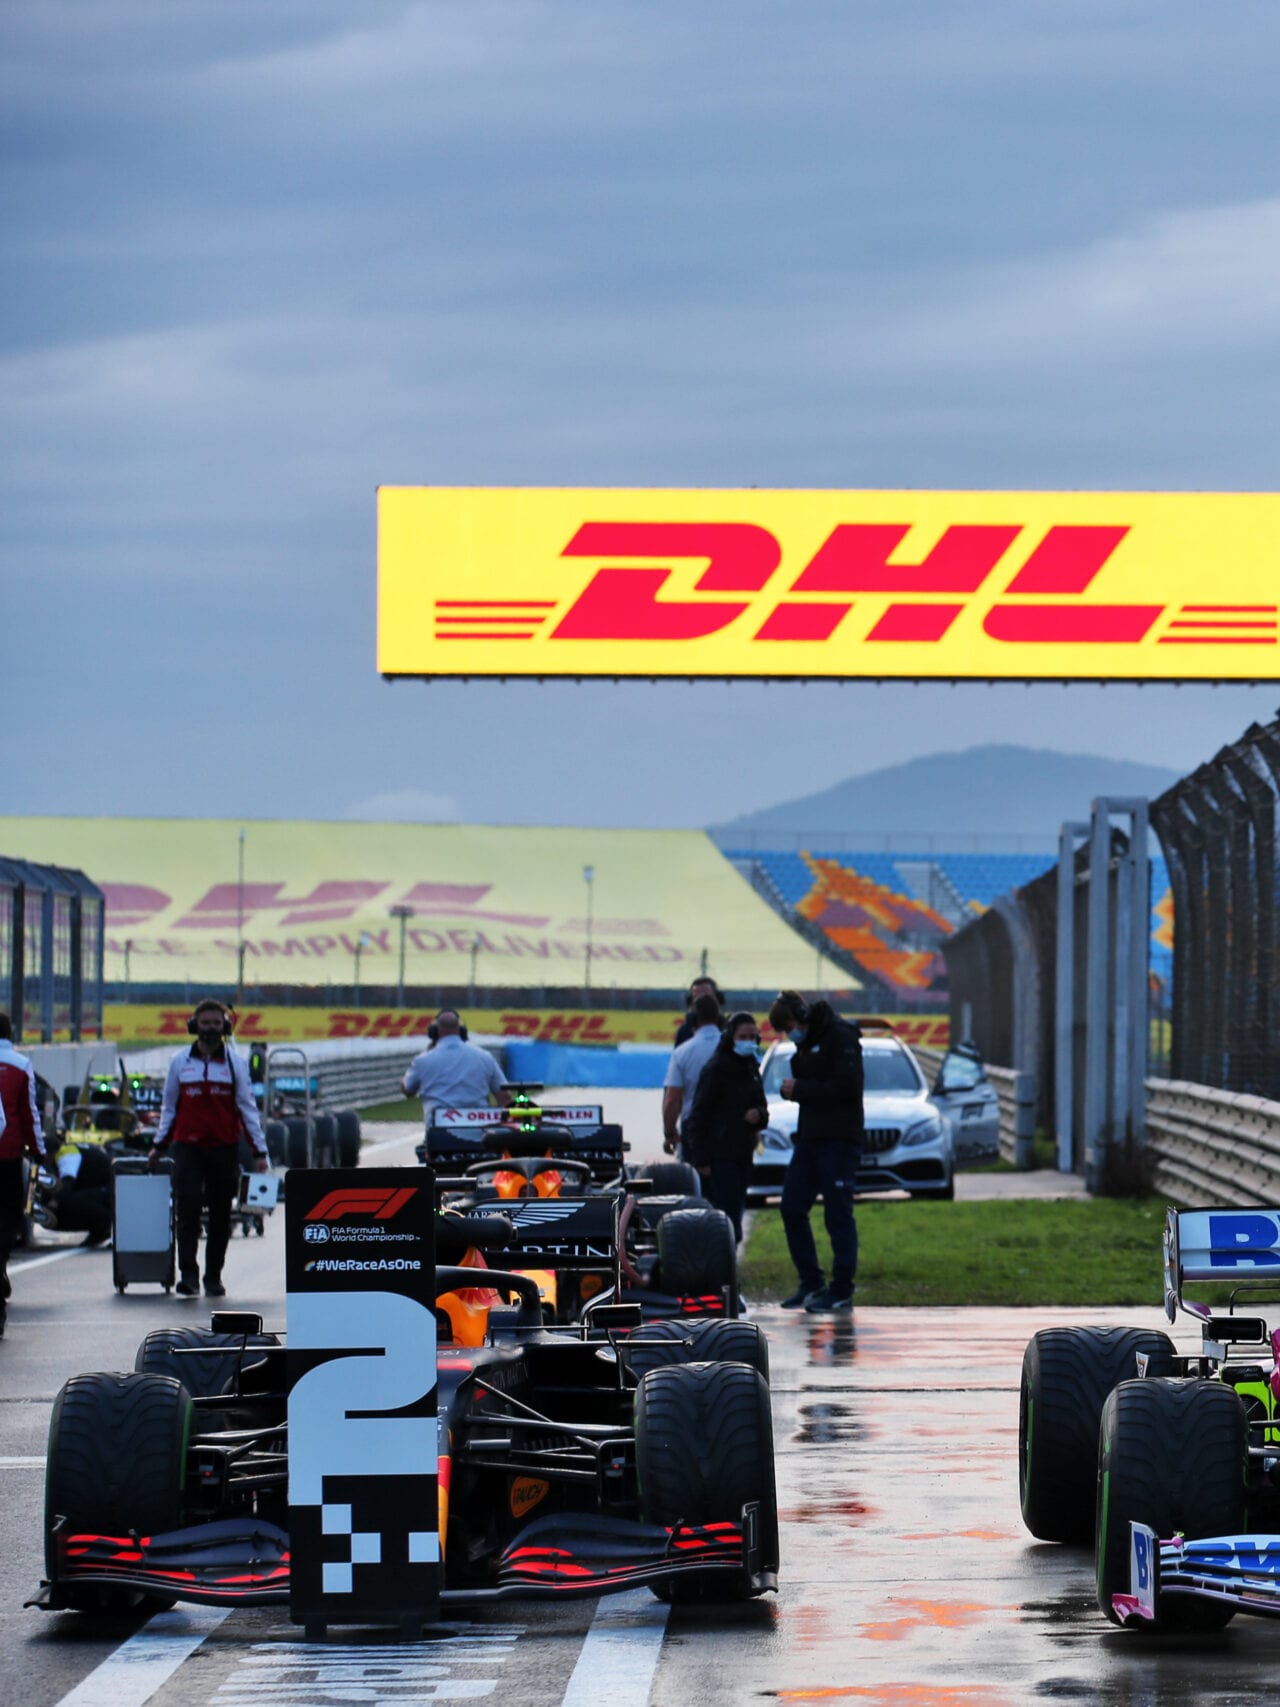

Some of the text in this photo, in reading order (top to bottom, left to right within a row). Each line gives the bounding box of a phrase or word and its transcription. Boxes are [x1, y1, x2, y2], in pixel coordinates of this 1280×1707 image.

[548, 521, 1168, 643] DHL
[157, 1011, 269, 1037] DL
[501, 1015, 612, 1042] DHL
[467, 1109, 502, 1122] ORLE
[331, 1233, 415, 1242] World Championship
[346, 1226, 379, 1234] Formula
[315, 1259, 421, 1271] #WeRaceAsOne
[286, 1291, 438, 1476] 2
